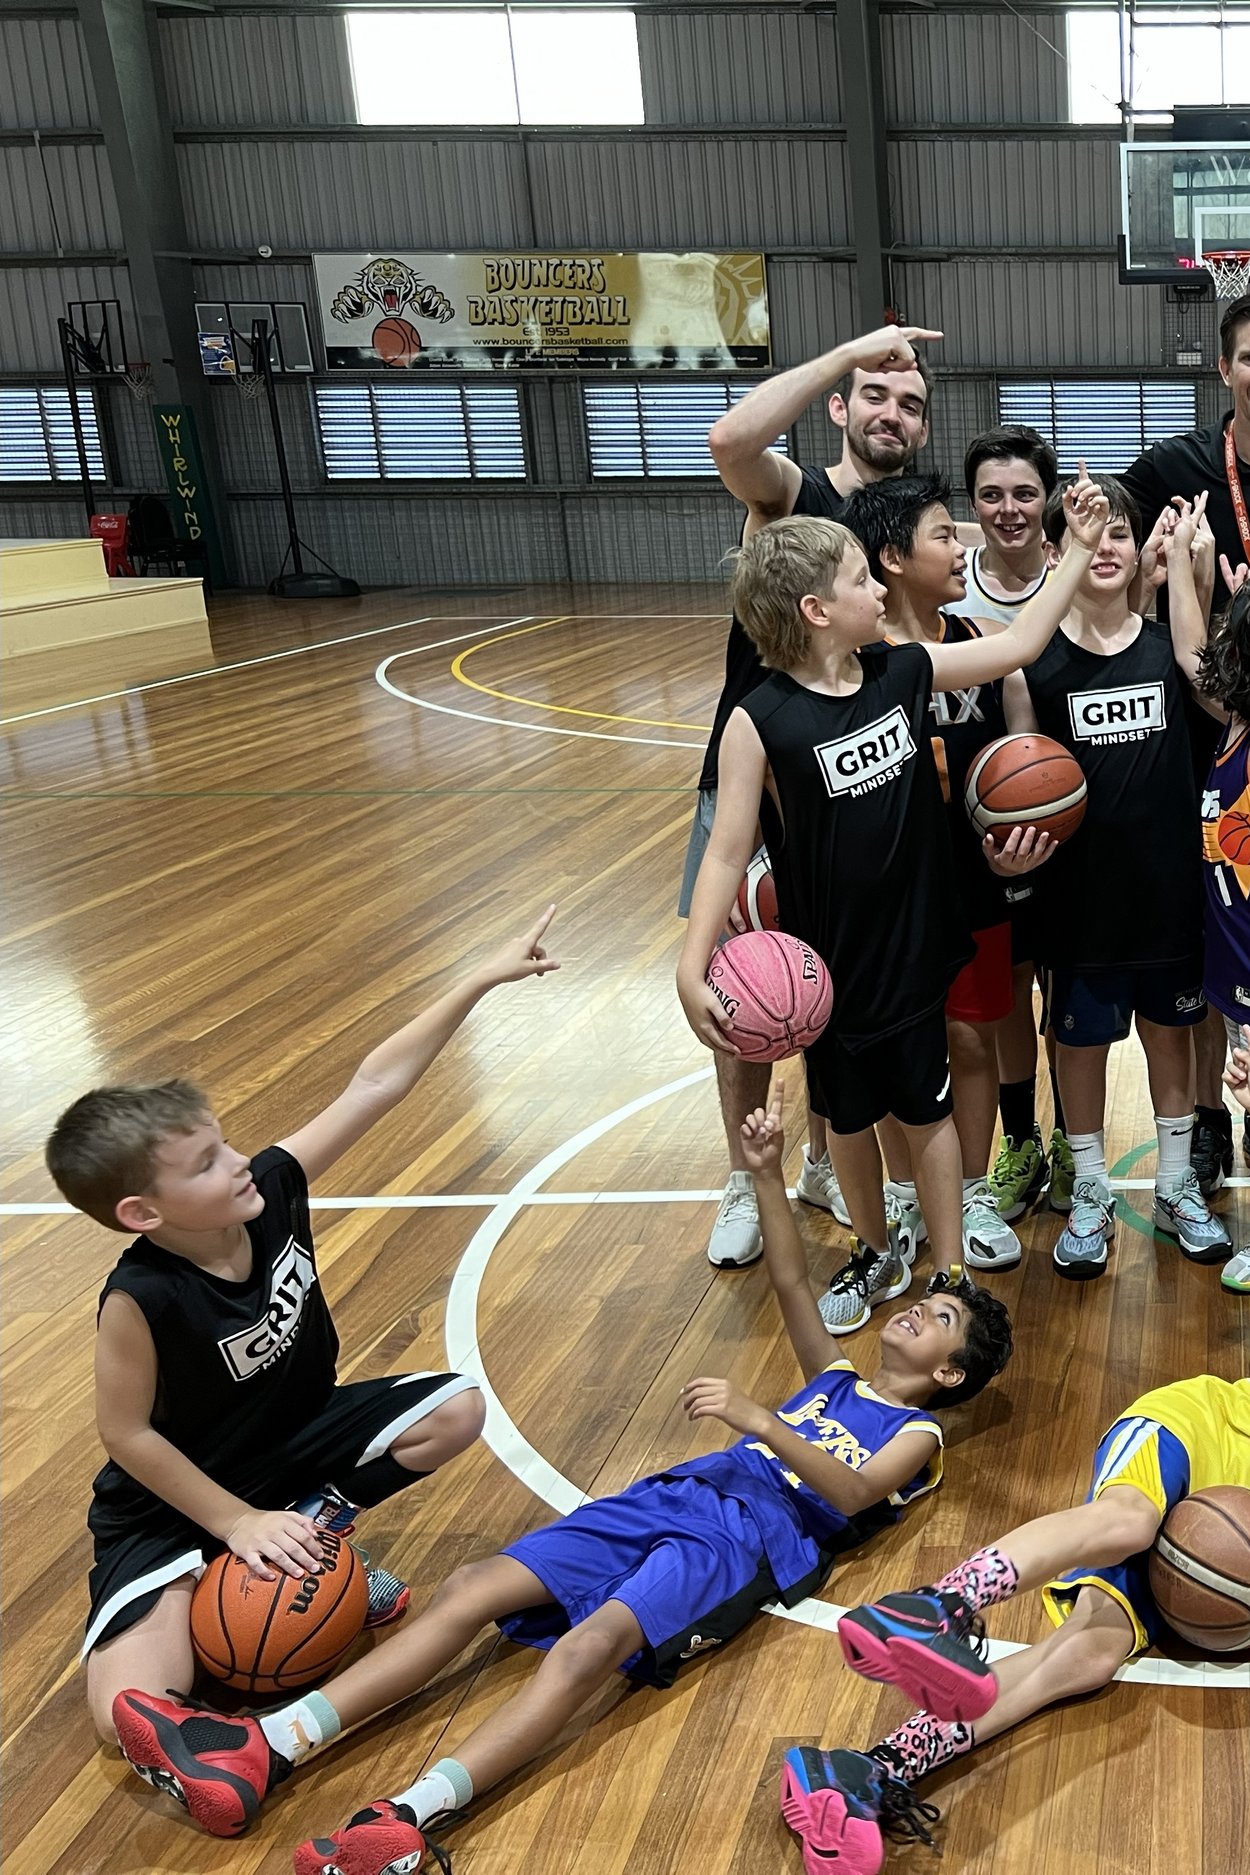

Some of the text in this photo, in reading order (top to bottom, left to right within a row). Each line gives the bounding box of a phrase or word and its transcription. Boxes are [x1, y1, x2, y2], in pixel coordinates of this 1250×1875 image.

[483, 258, 606, 293] BOUNCERS
[467, 295, 630, 326] BASKETBALL
[473, 337, 628, 346] www.bouncrsbasketball.com
[545, 327, 570, 336] 1953
[161, 414, 201, 541] WHIRLWIND
[1082, 696, 1155, 726] GRIT
[835, 723, 900, 777] GRIT
[1091, 729, 1151, 746] MINDSET
[850, 761, 904, 798] MINDSE
[245, 1260, 303, 1358] GRIT
